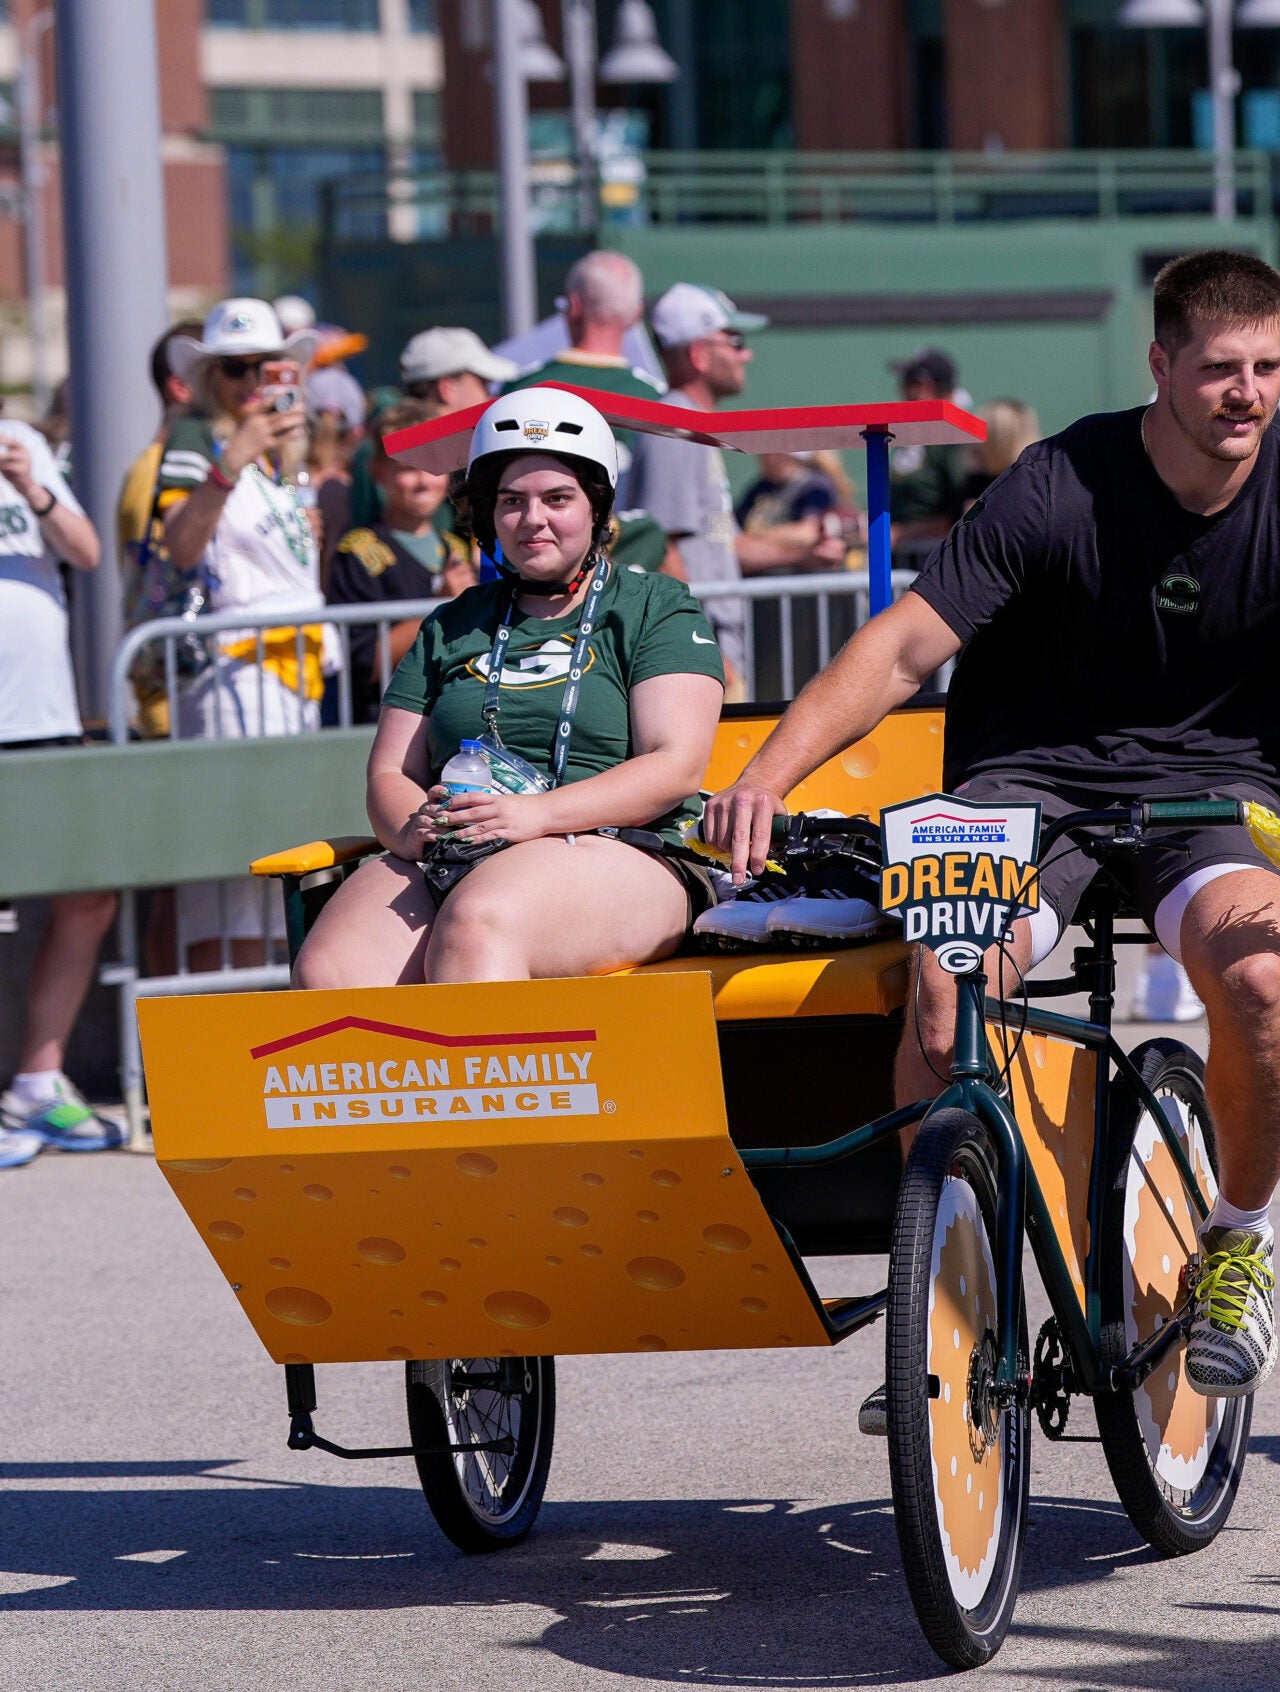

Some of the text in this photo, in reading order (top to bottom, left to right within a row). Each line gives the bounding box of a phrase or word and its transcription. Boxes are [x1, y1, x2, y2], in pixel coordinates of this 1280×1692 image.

[912, 824, 1006, 834] AMERICAN FAMILY
[919, 834, 999, 843] INSURANCE
[881, 853, 1040, 911] DREAM
[905, 900, 1014, 943] DRIVE
[263, 1051, 593, 1094] AMERICAN FAMILY
[291, 1091, 572, 1121] INSURANCE
